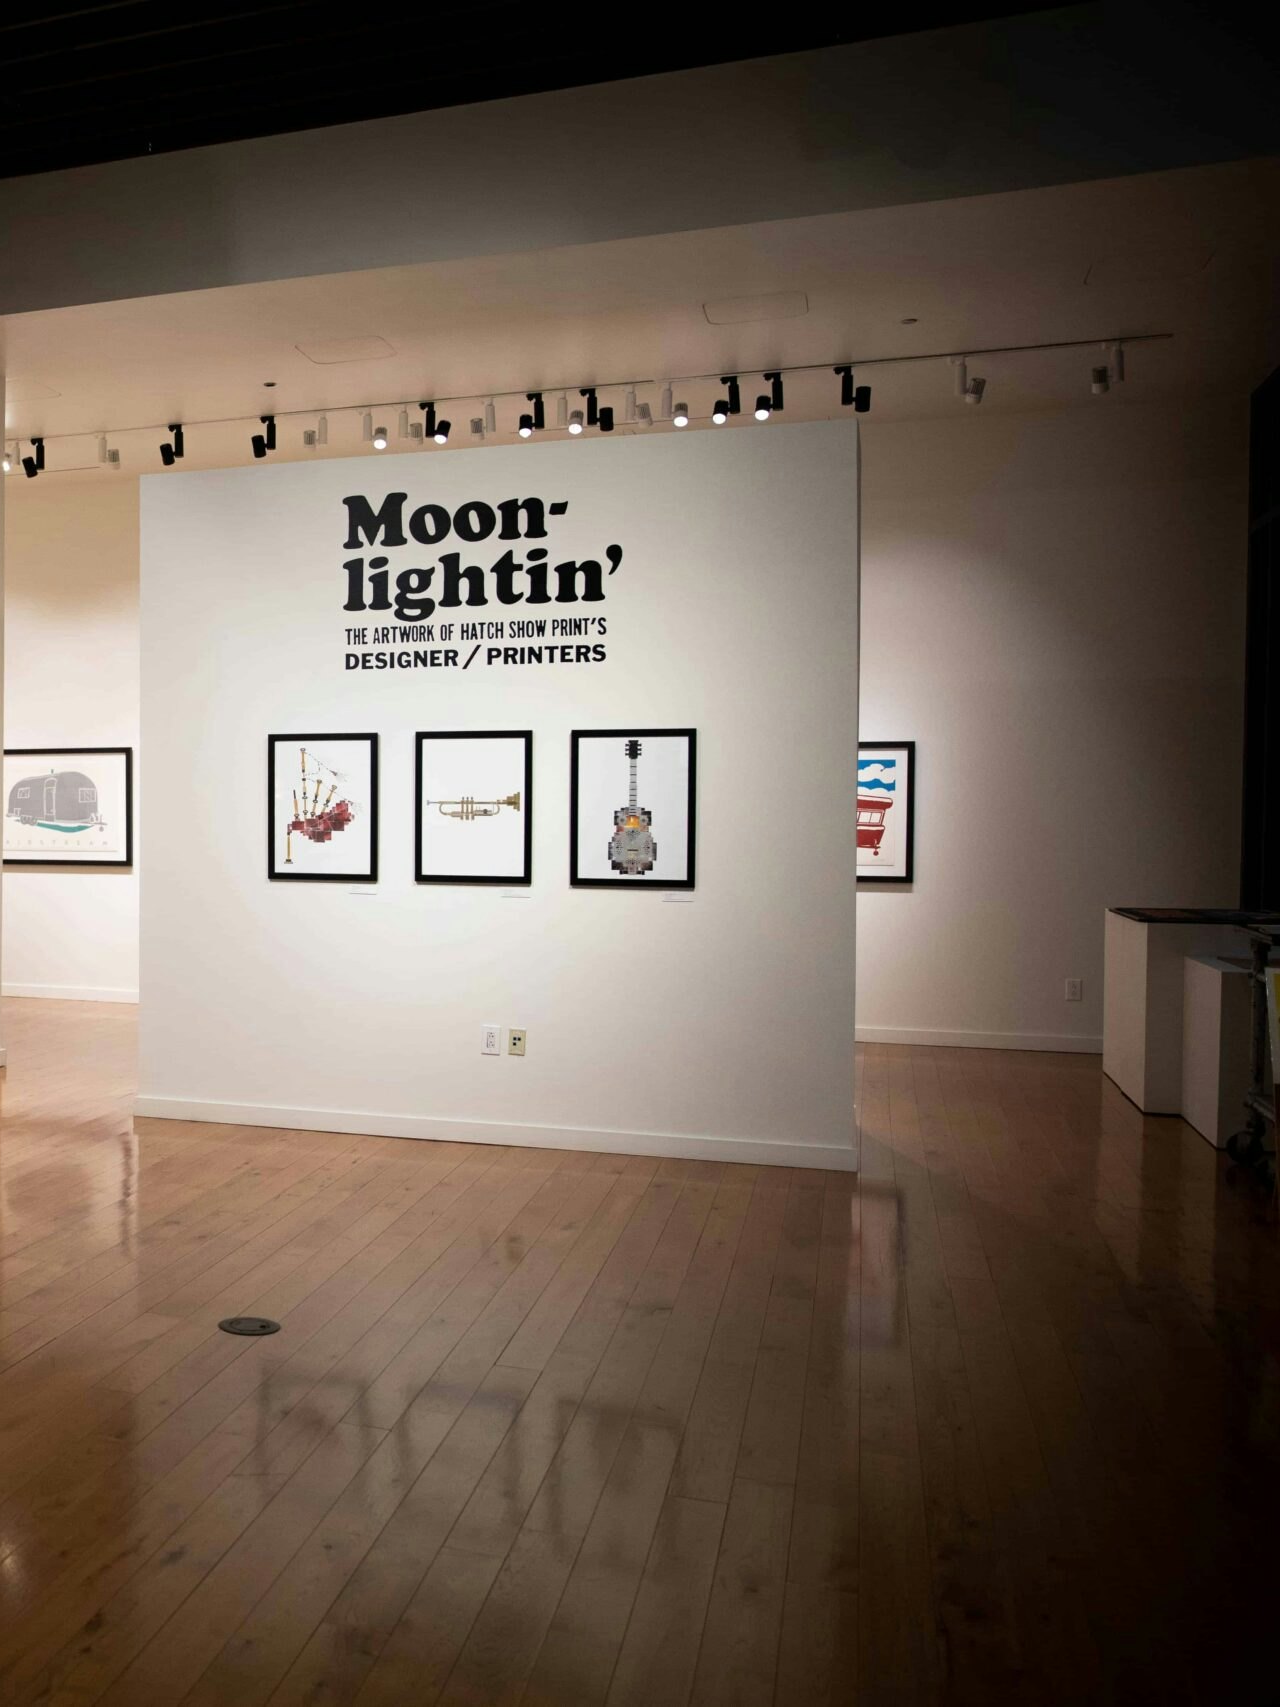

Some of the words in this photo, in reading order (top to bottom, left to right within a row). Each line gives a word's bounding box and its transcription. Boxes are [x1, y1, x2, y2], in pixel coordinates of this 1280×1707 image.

[342, 491, 568, 549] Moon-
[345, 628, 368, 645] THE
[373, 625, 435, 644] ARTWORK
[440, 623, 454, 642] OF
[460, 621, 504, 641] HATCH
[509, 619, 546, 638] SHOW
[552, 617, 607, 636] PRINT'S
[345, 649, 459, 670] DESIGNER
[487, 644, 607, 665] PRINTERS
